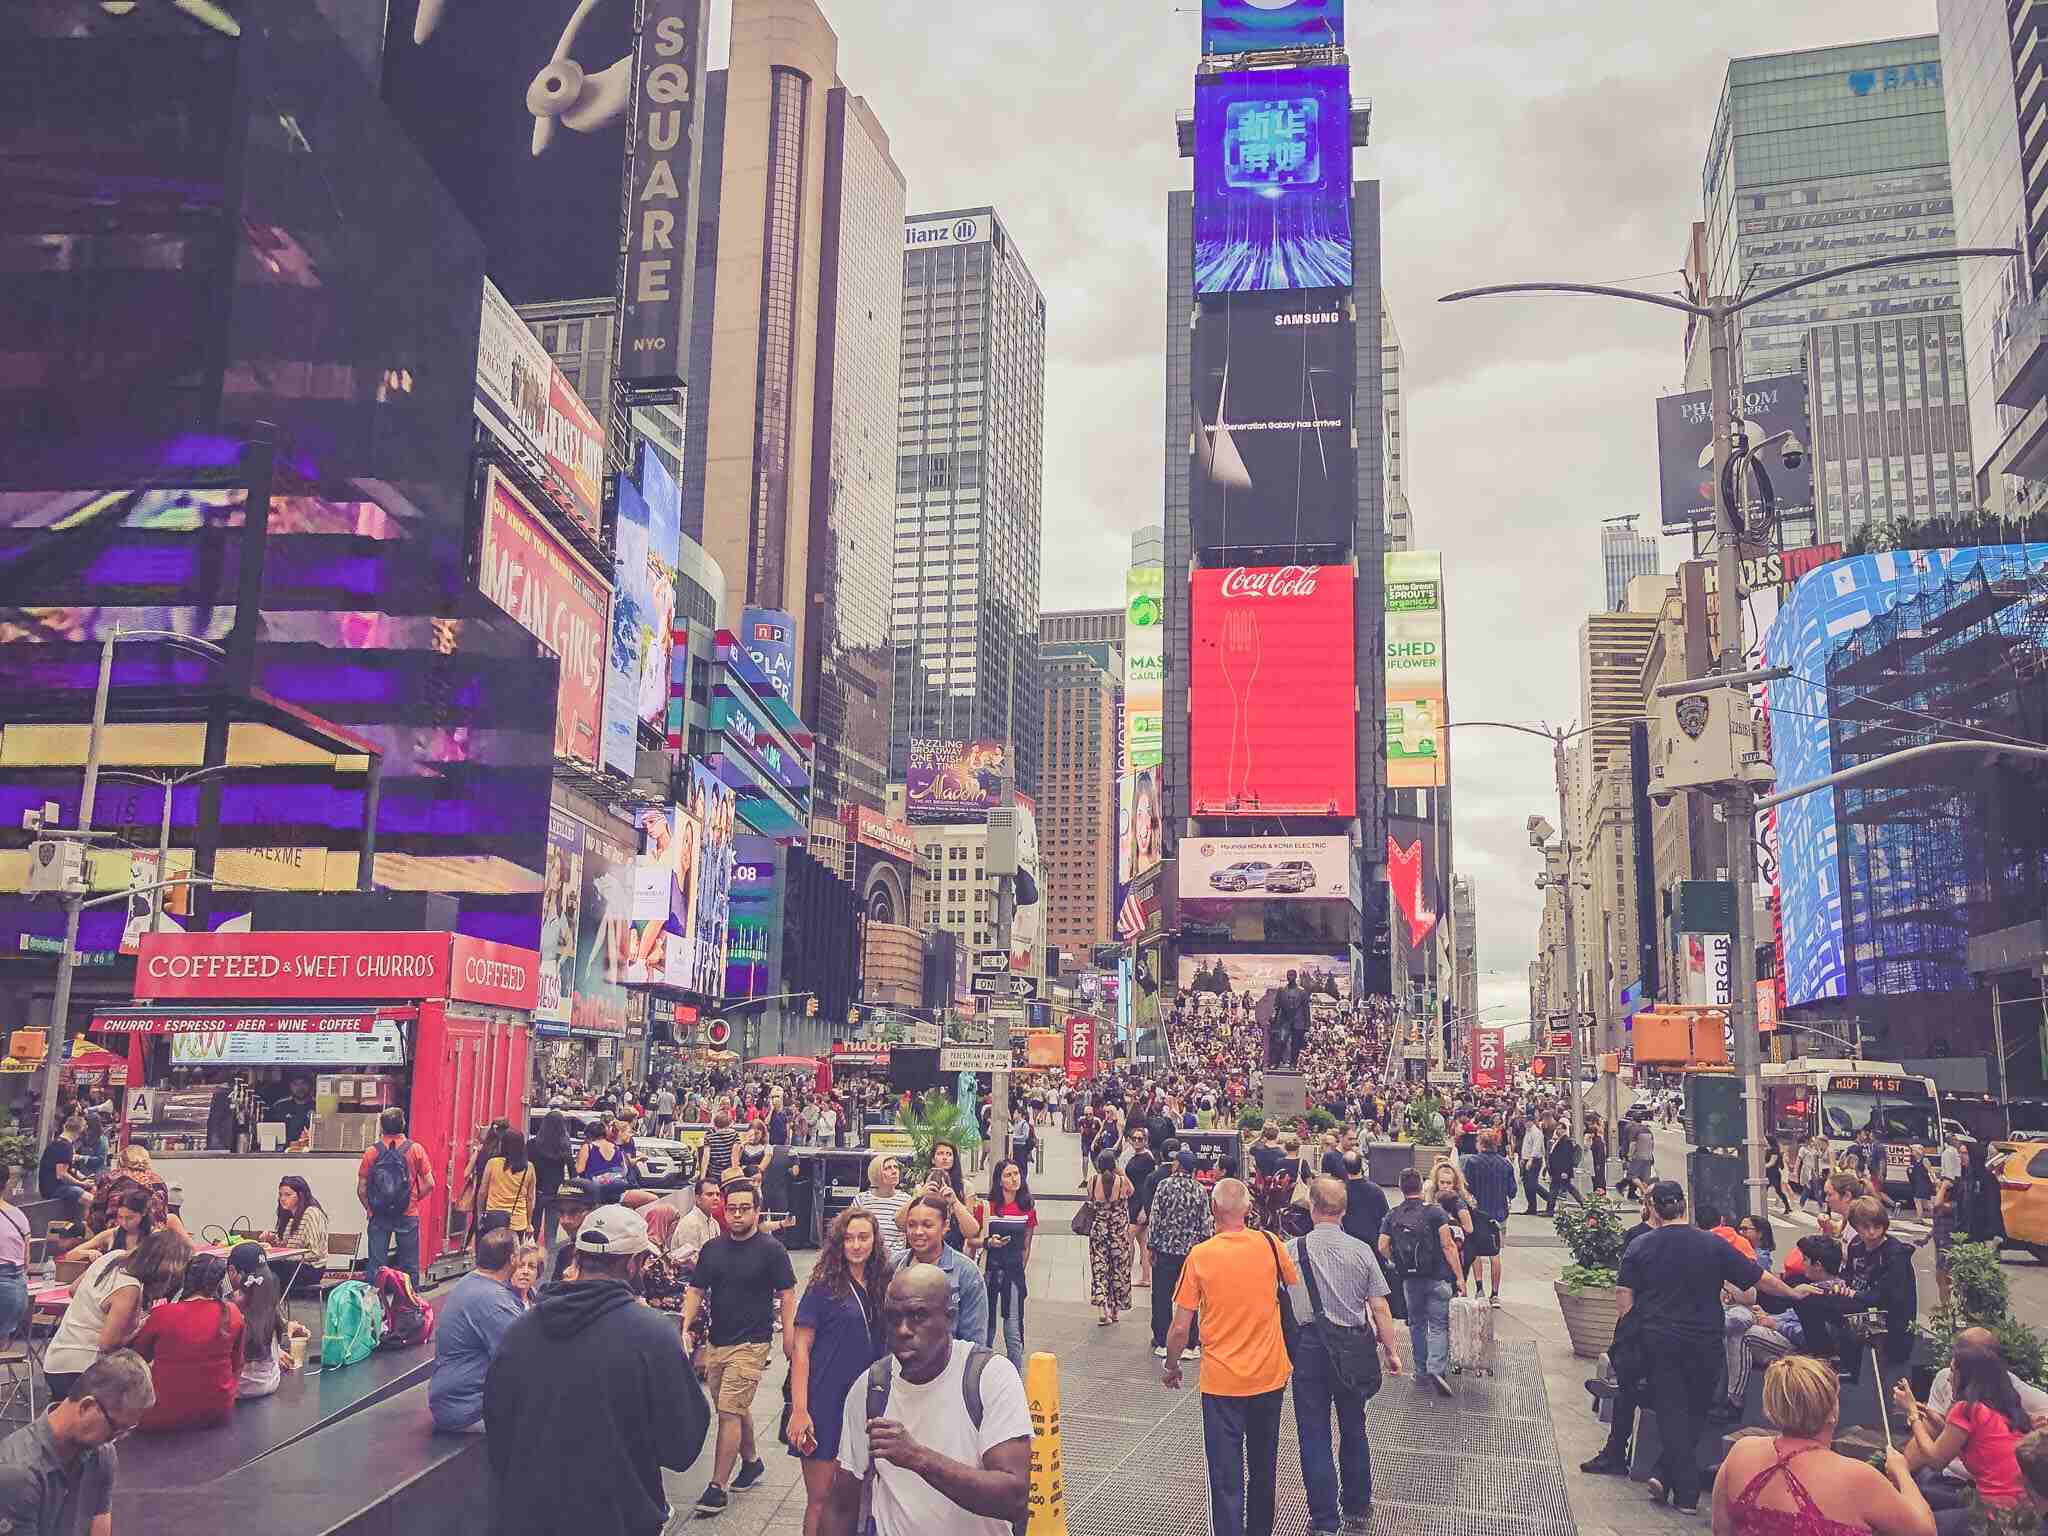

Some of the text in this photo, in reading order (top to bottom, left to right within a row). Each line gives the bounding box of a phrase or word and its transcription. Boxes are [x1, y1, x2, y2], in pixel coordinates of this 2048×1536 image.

[636, 16, 689, 302] SQUARE
[1275, 312, 1339, 326] SAMSUNG
[633, 338, 666, 350] NYC
[1680, 389, 1778, 419] PHAOM
[1224, 423, 1267, 431] Generation
[1268, 421, 1295, 430] Galaxy
[1313, 419, 1341, 427] arrived
[1221, 565, 1320, 597] Coca-Cola
[1390, 590, 1434, 600] SPROUT'S
[480, 540, 602, 697] MEAN GIRLS
[1387, 642, 1436, 656] SHED
[911, 738, 963, 748] DAZZLING
[911, 753, 963, 763] ONE WISH
[911, 761, 923, 769] AT
[936, 762, 960, 770] TIME
[148, 954, 434, 978] COFFEED & SWEET CHURROS
[465, 956, 526, 993] COFFEED
[980, 980, 995, 990] ON
[103, 1018, 361, 1031] CHURRO ESPRESSO BEER WINE COFFEE
[1072, 1021, 1091, 1058] tkts
[1479, 1031, 1499, 1071] tkts
[1887, 1079, 1902, 1092] ST
[133, 1093, 149, 1111] A
